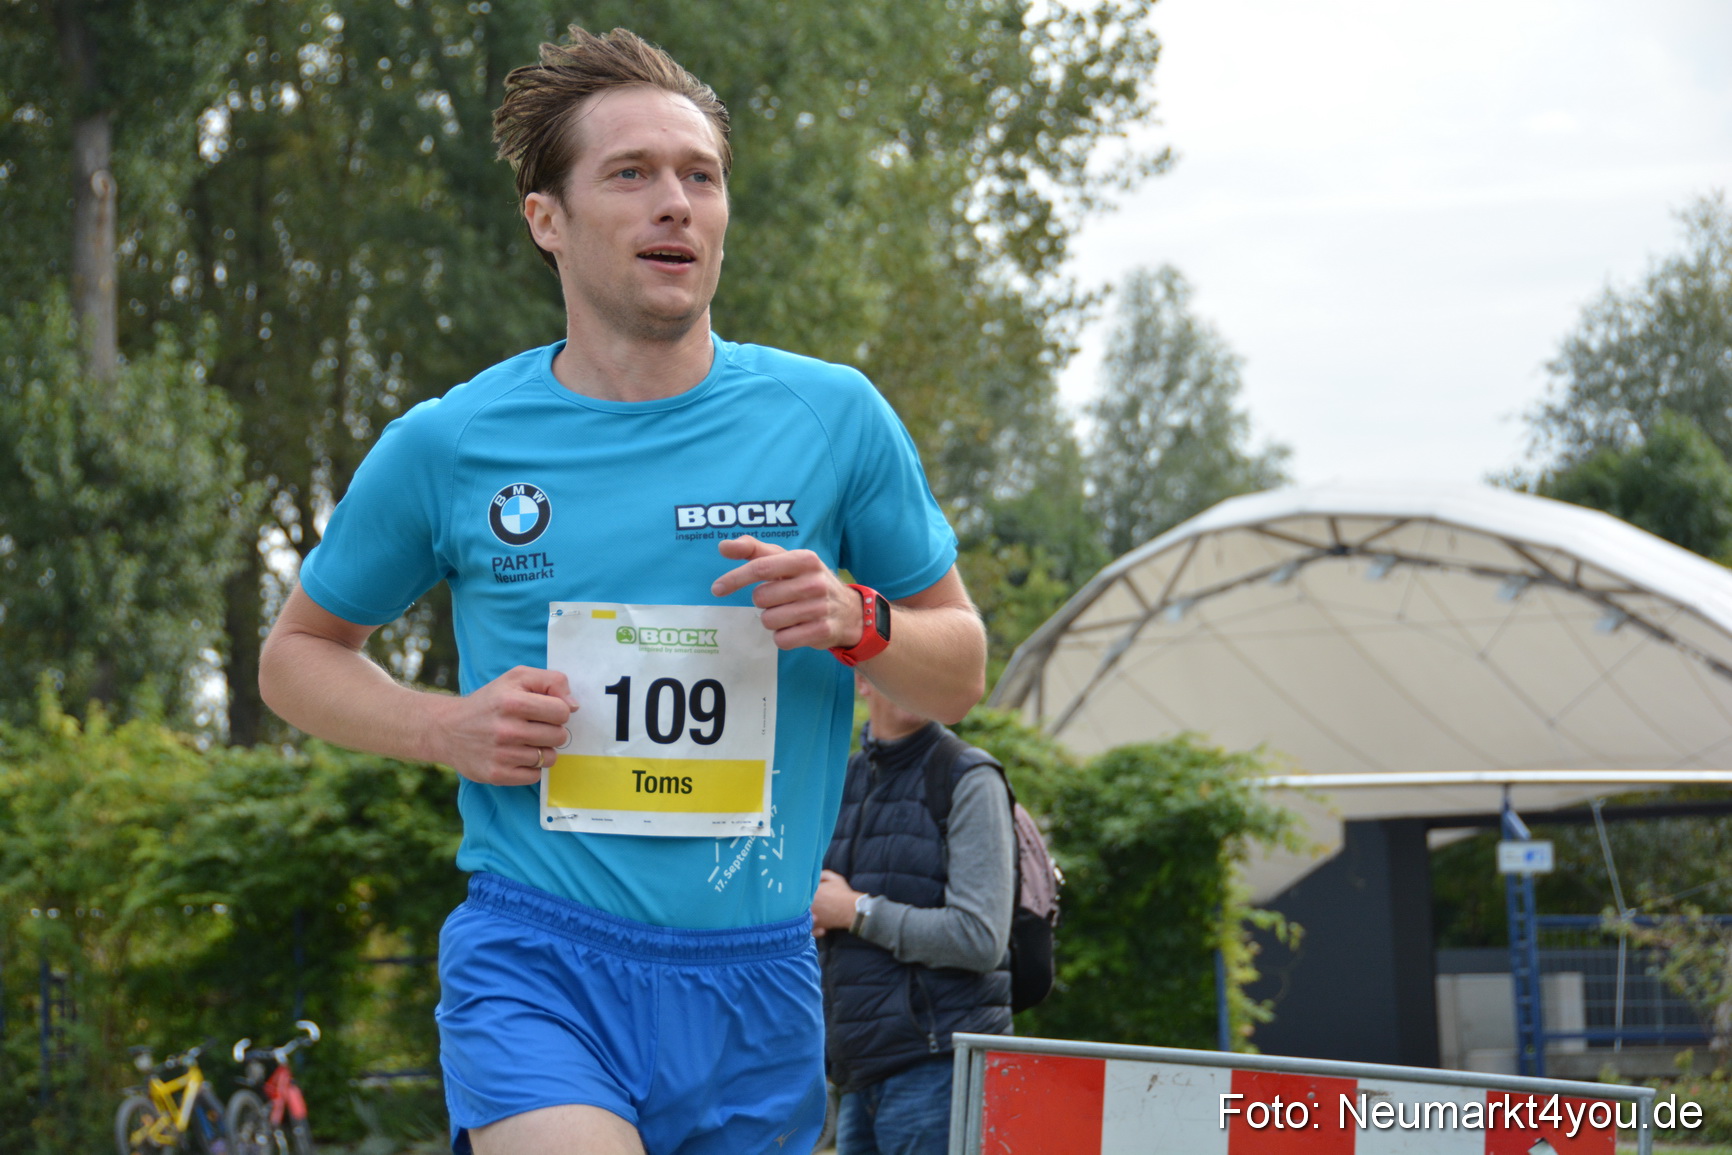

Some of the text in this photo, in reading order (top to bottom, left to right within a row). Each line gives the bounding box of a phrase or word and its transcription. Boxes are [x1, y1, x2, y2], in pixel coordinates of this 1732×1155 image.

[494, 485, 546, 507] BMW
[675, 500, 798, 530] BOCK
[675, 531, 715, 541] inspired
[717, 530, 728, 539] by
[760, 529, 799, 538] concepts
[492, 552, 554, 572] PARTL
[494, 568, 555, 584] Neumarkt
[638, 627, 719, 647] BOCK
[605, 675, 726, 745] 109
[632, 769, 693, 795] Toms
[714, 879, 729, 893] 17.
[723, 836, 756, 880] Septemb
